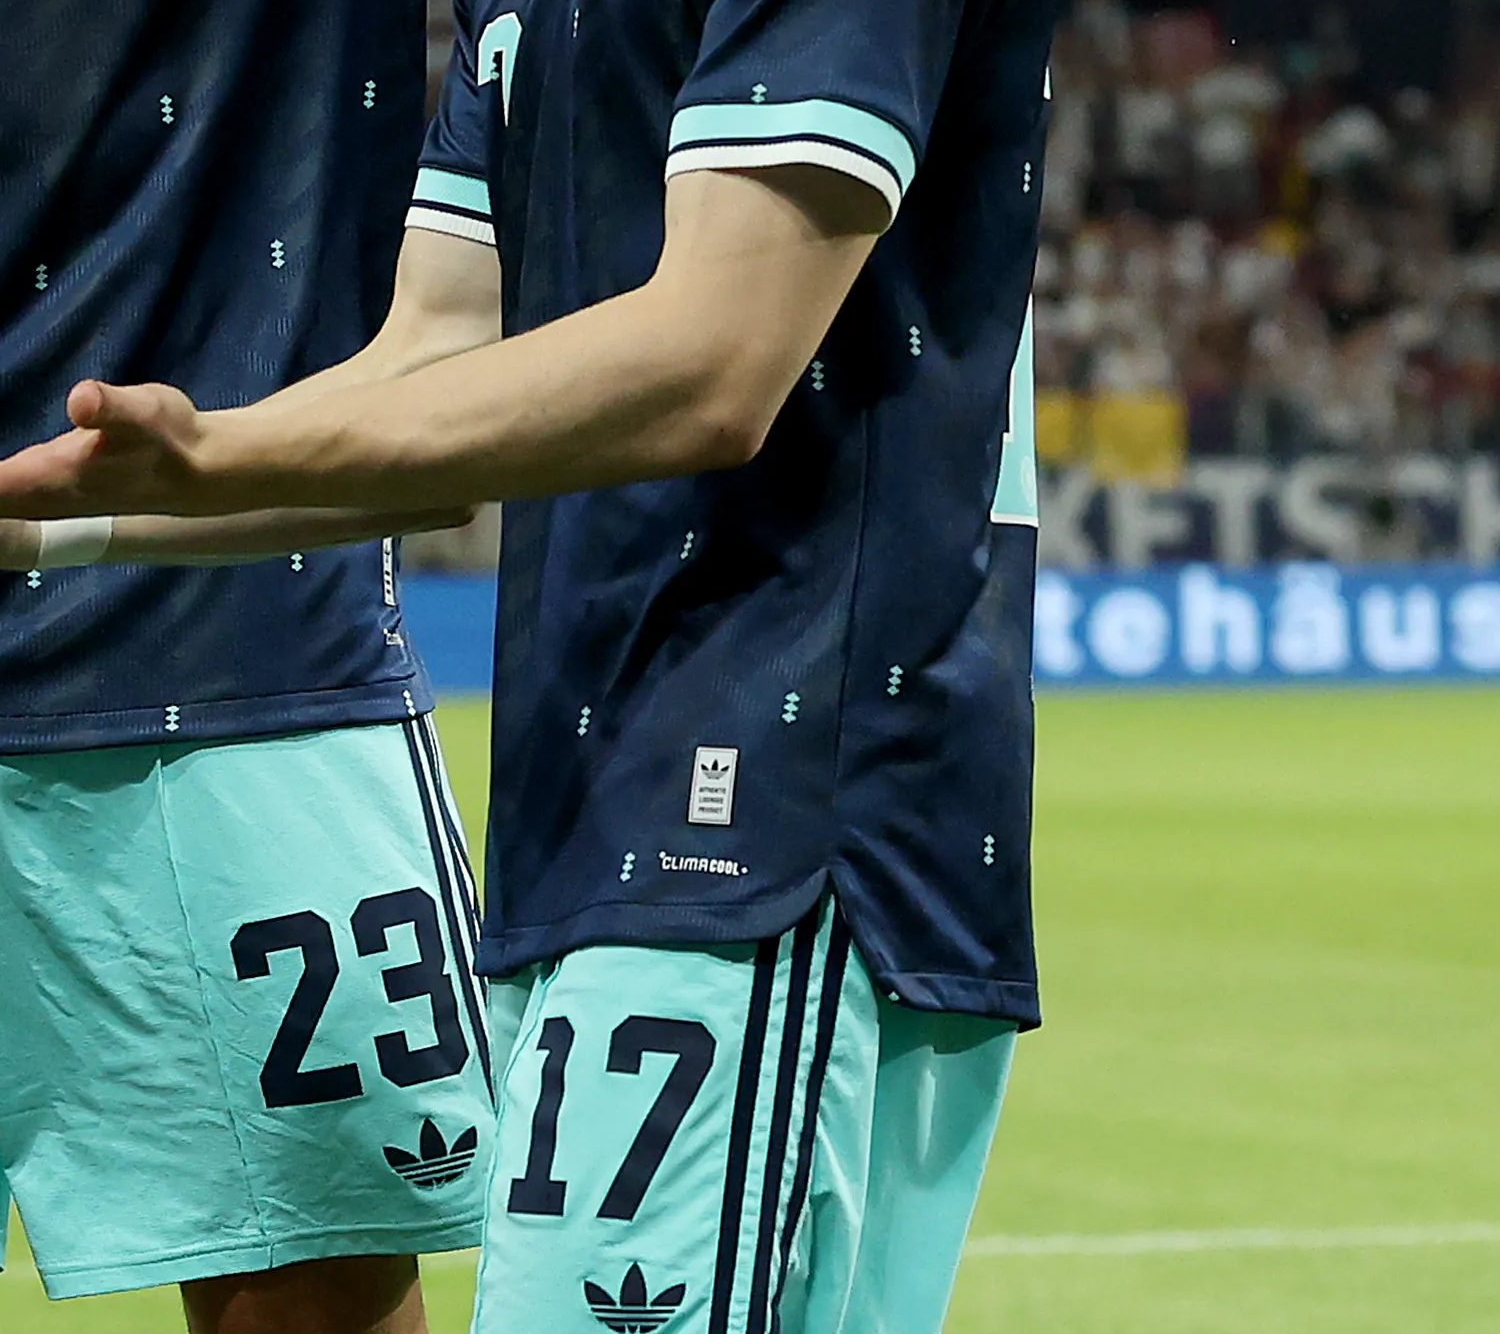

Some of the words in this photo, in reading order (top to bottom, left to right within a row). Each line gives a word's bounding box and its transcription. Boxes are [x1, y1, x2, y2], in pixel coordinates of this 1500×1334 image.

[661, 855, 740, 876] CLIMACOOL
[229, 886, 471, 1109] 23
[506, 1015, 716, 1220] 17
